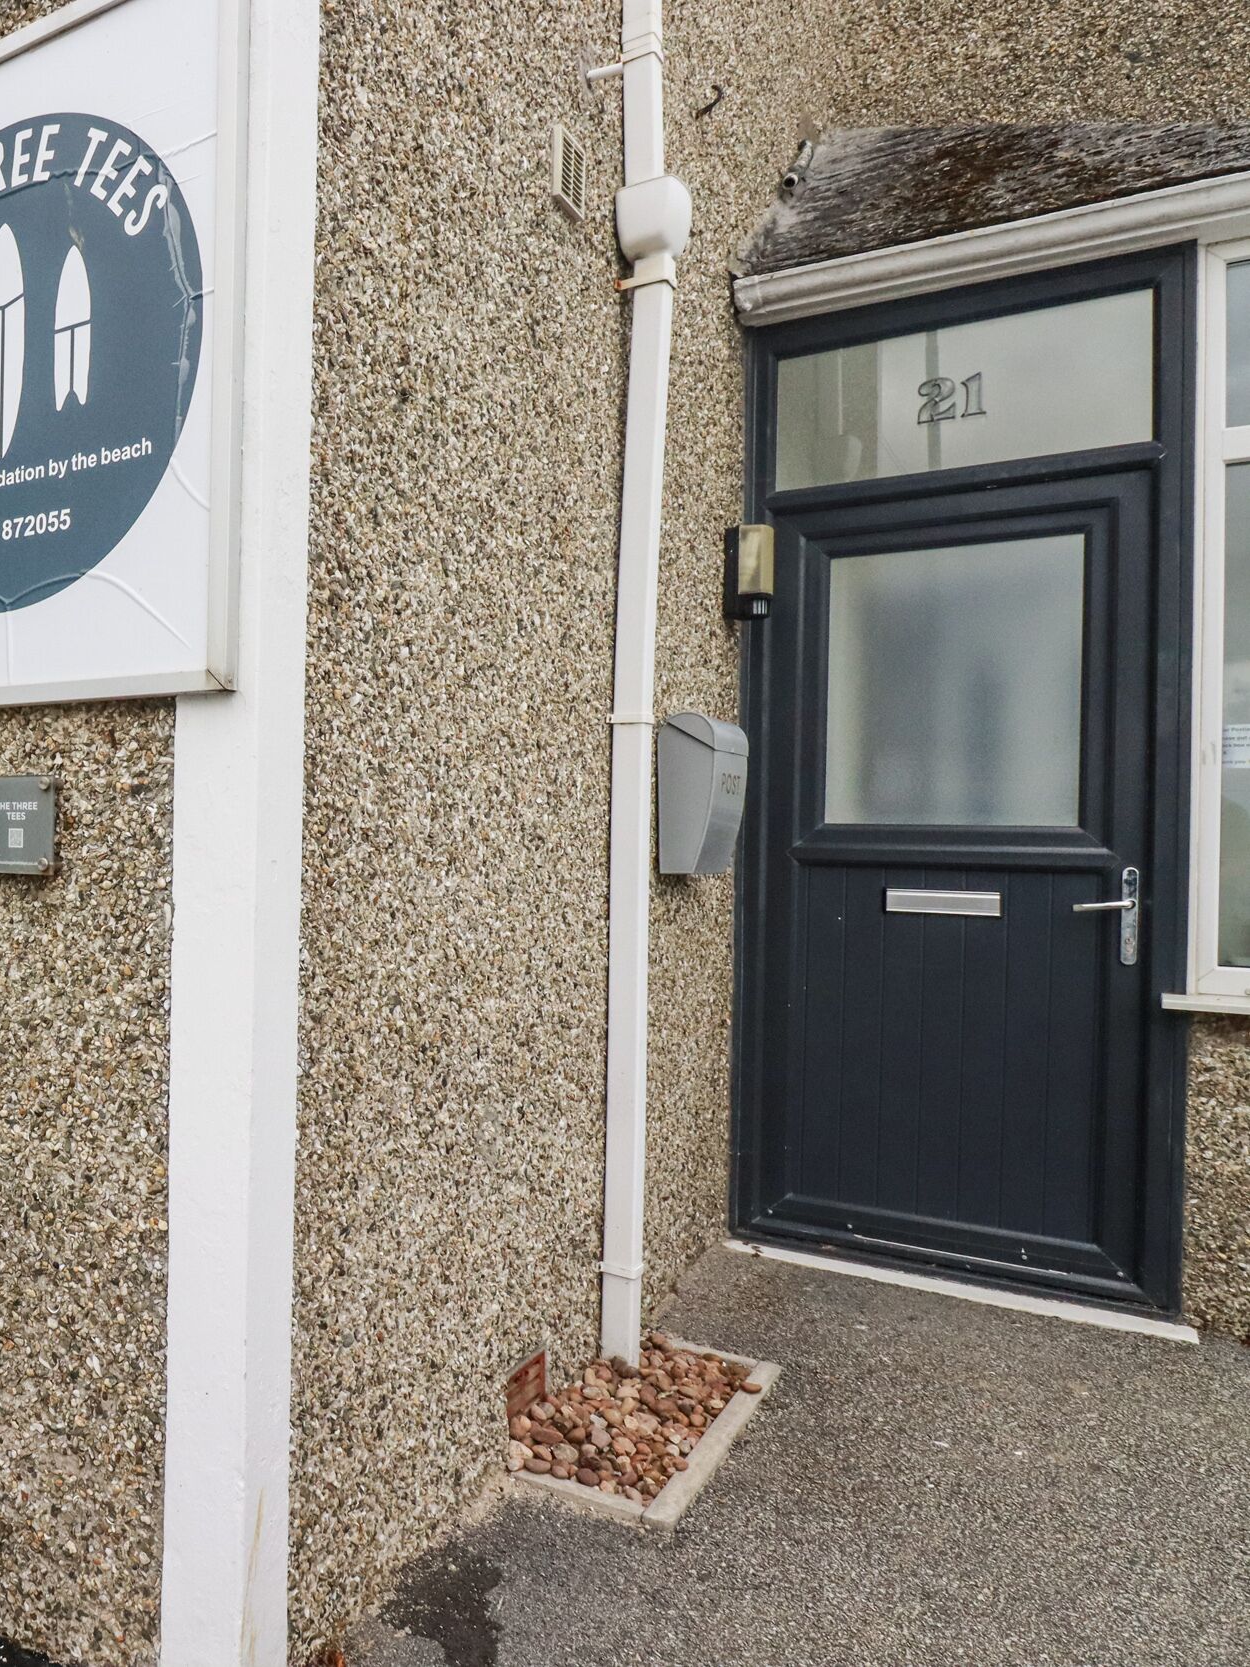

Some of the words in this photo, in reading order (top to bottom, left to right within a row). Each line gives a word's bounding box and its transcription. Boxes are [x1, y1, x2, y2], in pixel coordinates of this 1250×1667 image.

[74, 127, 167, 236] TEES
[917, 371, 987, 425] 21
[48, 458, 69, 478] by
[71, 451, 97, 471] the
[100, 437, 152, 464] beach
[2, 508, 71, 541] 872055
[721, 772, 741, 795] POST
[6, 811, 26, 821] TEES
[12, 801, 38, 811] THREE
